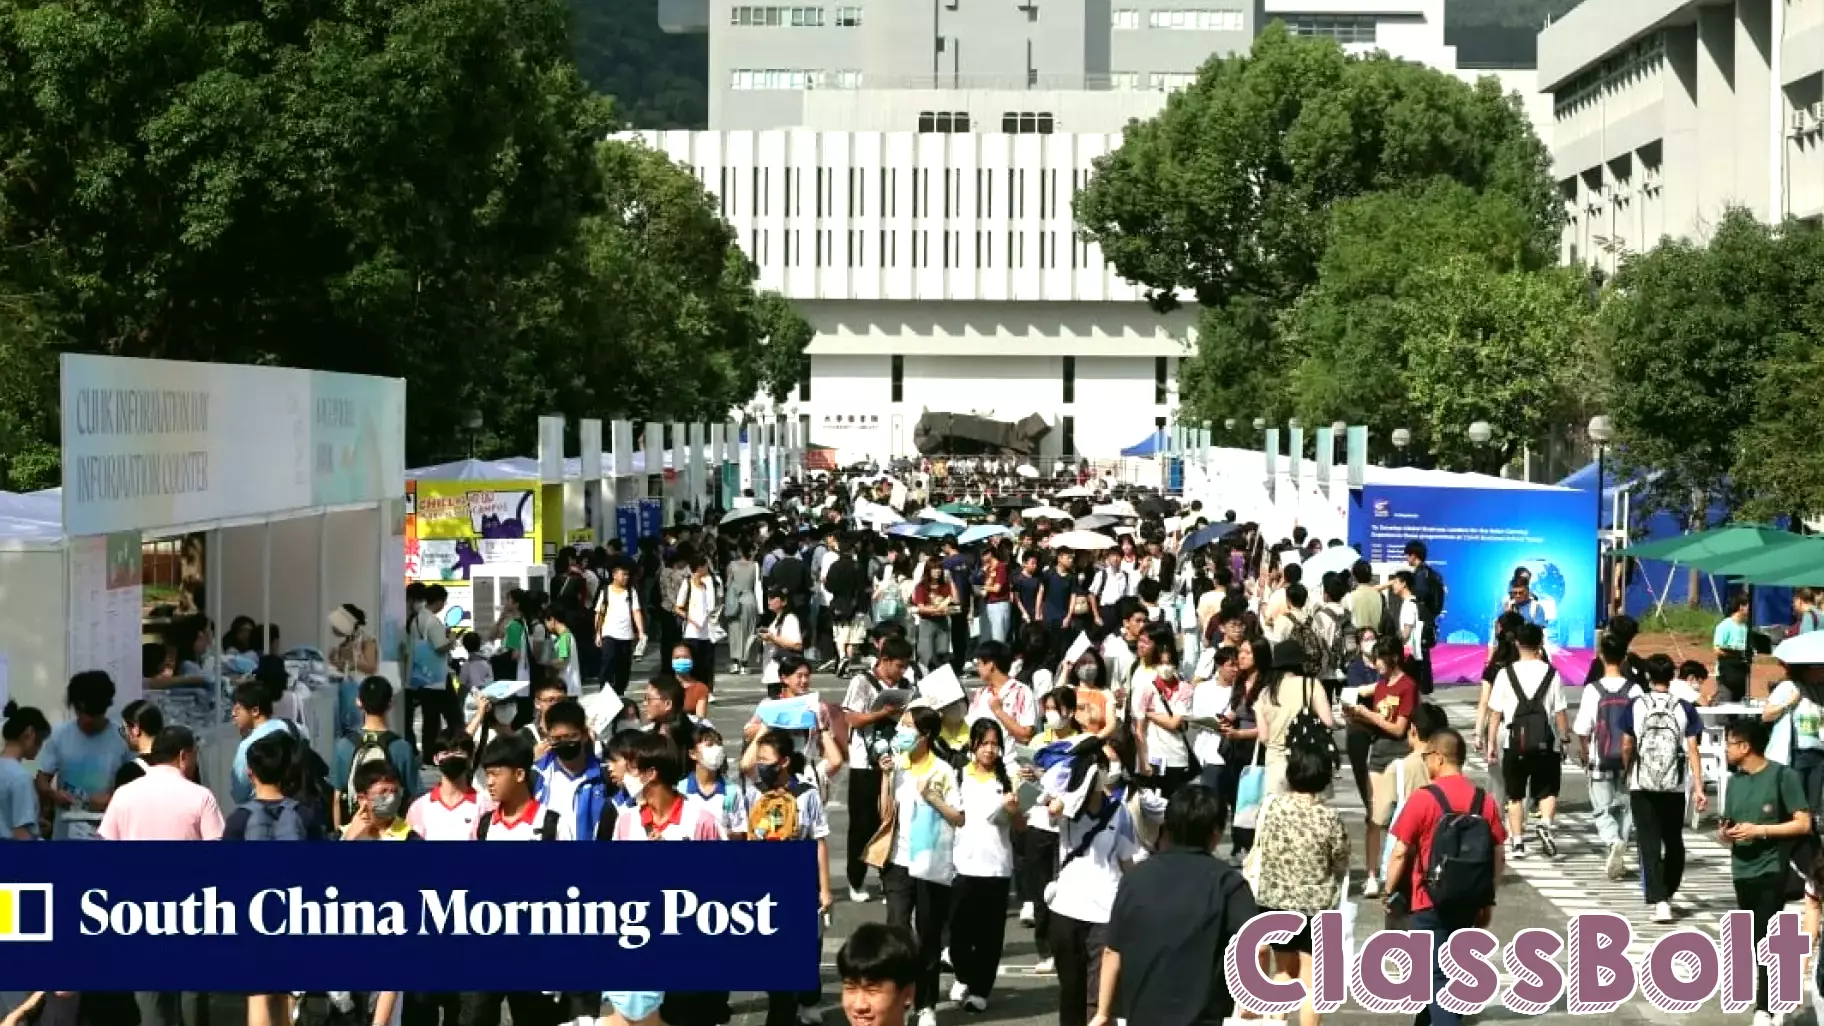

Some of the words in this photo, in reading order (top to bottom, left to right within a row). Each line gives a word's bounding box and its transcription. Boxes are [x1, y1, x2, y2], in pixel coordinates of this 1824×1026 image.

[76, 388, 114, 434] CUHK
[116, 389, 189, 434] INFORMATION
[77, 454, 160, 503] INFORMATION
